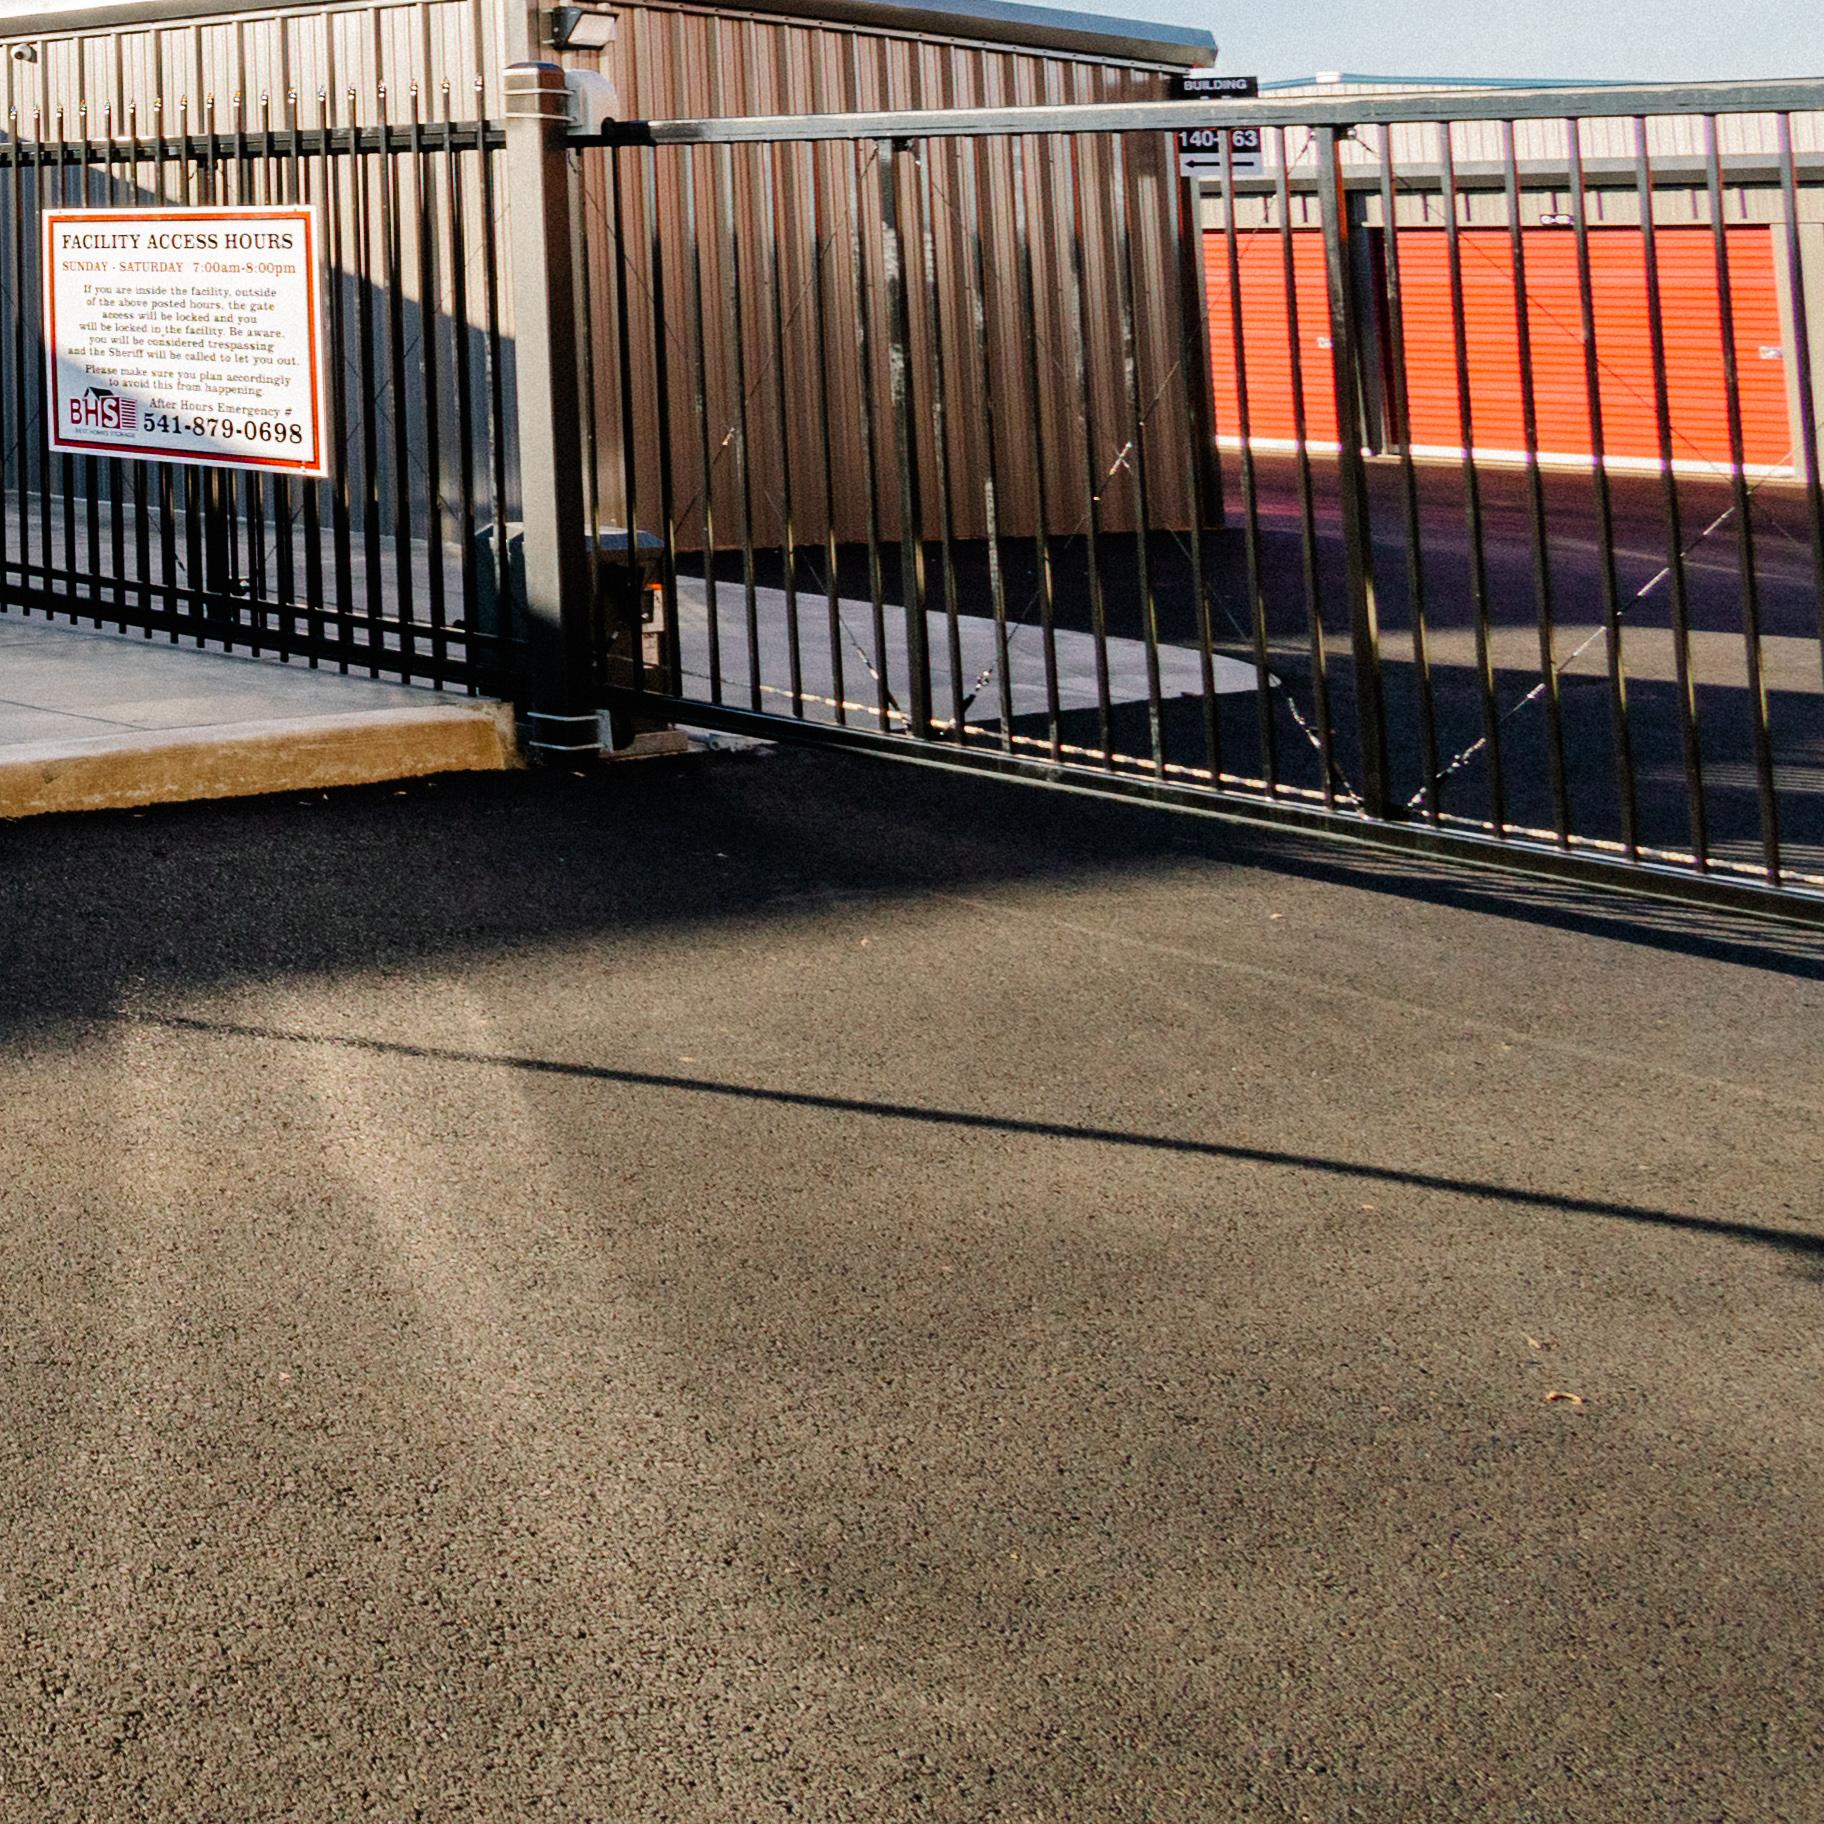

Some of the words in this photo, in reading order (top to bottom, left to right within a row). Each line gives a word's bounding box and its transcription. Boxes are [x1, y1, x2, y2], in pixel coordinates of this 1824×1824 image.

[1183, 79, 1248, 91] BUILDING
[1179, 130, 1257, 147] 140-63
[62, 234, 140, 250] FACILITY
[147, 233, 218, 249] ACCESS
[224, 233, 294, 249] HOURS
[62, 261, 108, 272] SUNDAY
[119, 261, 183, 273] SATURDAY
[84, 284, 92, 293] If
[95, 286, 112, 295] you
[136, 285, 167, 295] inside
[171, 286, 187, 295] the
[235, 288, 277, 297] outside
[86, 297, 96, 306] of
[99, 297, 115, 306] the
[118, 298, 148, 307] above
[152, 299, 186, 310] posted
[228, 300, 247, 310] the
[250, 302, 275, 312] gate
[102, 311, 135, 319] access
[138, 311, 157, 320] will
[160, 312, 173, 321] be
[176, 312, 210, 322] locked
[214, 314, 233, 323] and
[237, 315, 257, 325] you
[79, 322, 97, 331] will
[100, 323, 112, 331] be
[115, 323, 147, 333] locked
[151, 325, 161, 333] in
[165, 324, 183, 334] the
[229, 326, 243, 336] Be
[89, 336, 107, 345] you
[110, 336, 129, 345] will
[132, 336, 144, 345] be
[147, 337, 204, 348] considered
[208, 340, 274, 353] trespassing
[68, 347, 86, 355] and
[89, 347, 106, 356] the
[108, 347, 144, 358] Sheriff
[147, 350, 166, 359] will
[169, 350, 181, 360] be
[185, 351, 216, 361] called
[220, 353, 231, 362] to
[235, 353, 249, 363] let
[253, 356, 273, 366] you
[85, 364, 118, 375] Please
[120, 366, 147, 376] make
[151, 369, 174, 378] sure
[177, 370, 196, 380] you
[200, 371, 223, 382] plan
[226, 373, 291, 387] accordingly
[109, 378, 119, 387] to
[122, 379, 150, 388] avoid
[153, 380, 173, 390] this
[177, 381, 201, 392] from
[70, 396, 120, 430] BHS
[149, 397, 176, 409] After
[180, 399, 213, 412] Hours
[218, 402, 280, 419] Emergency
[143, 412, 302, 444] 541-879-0698
